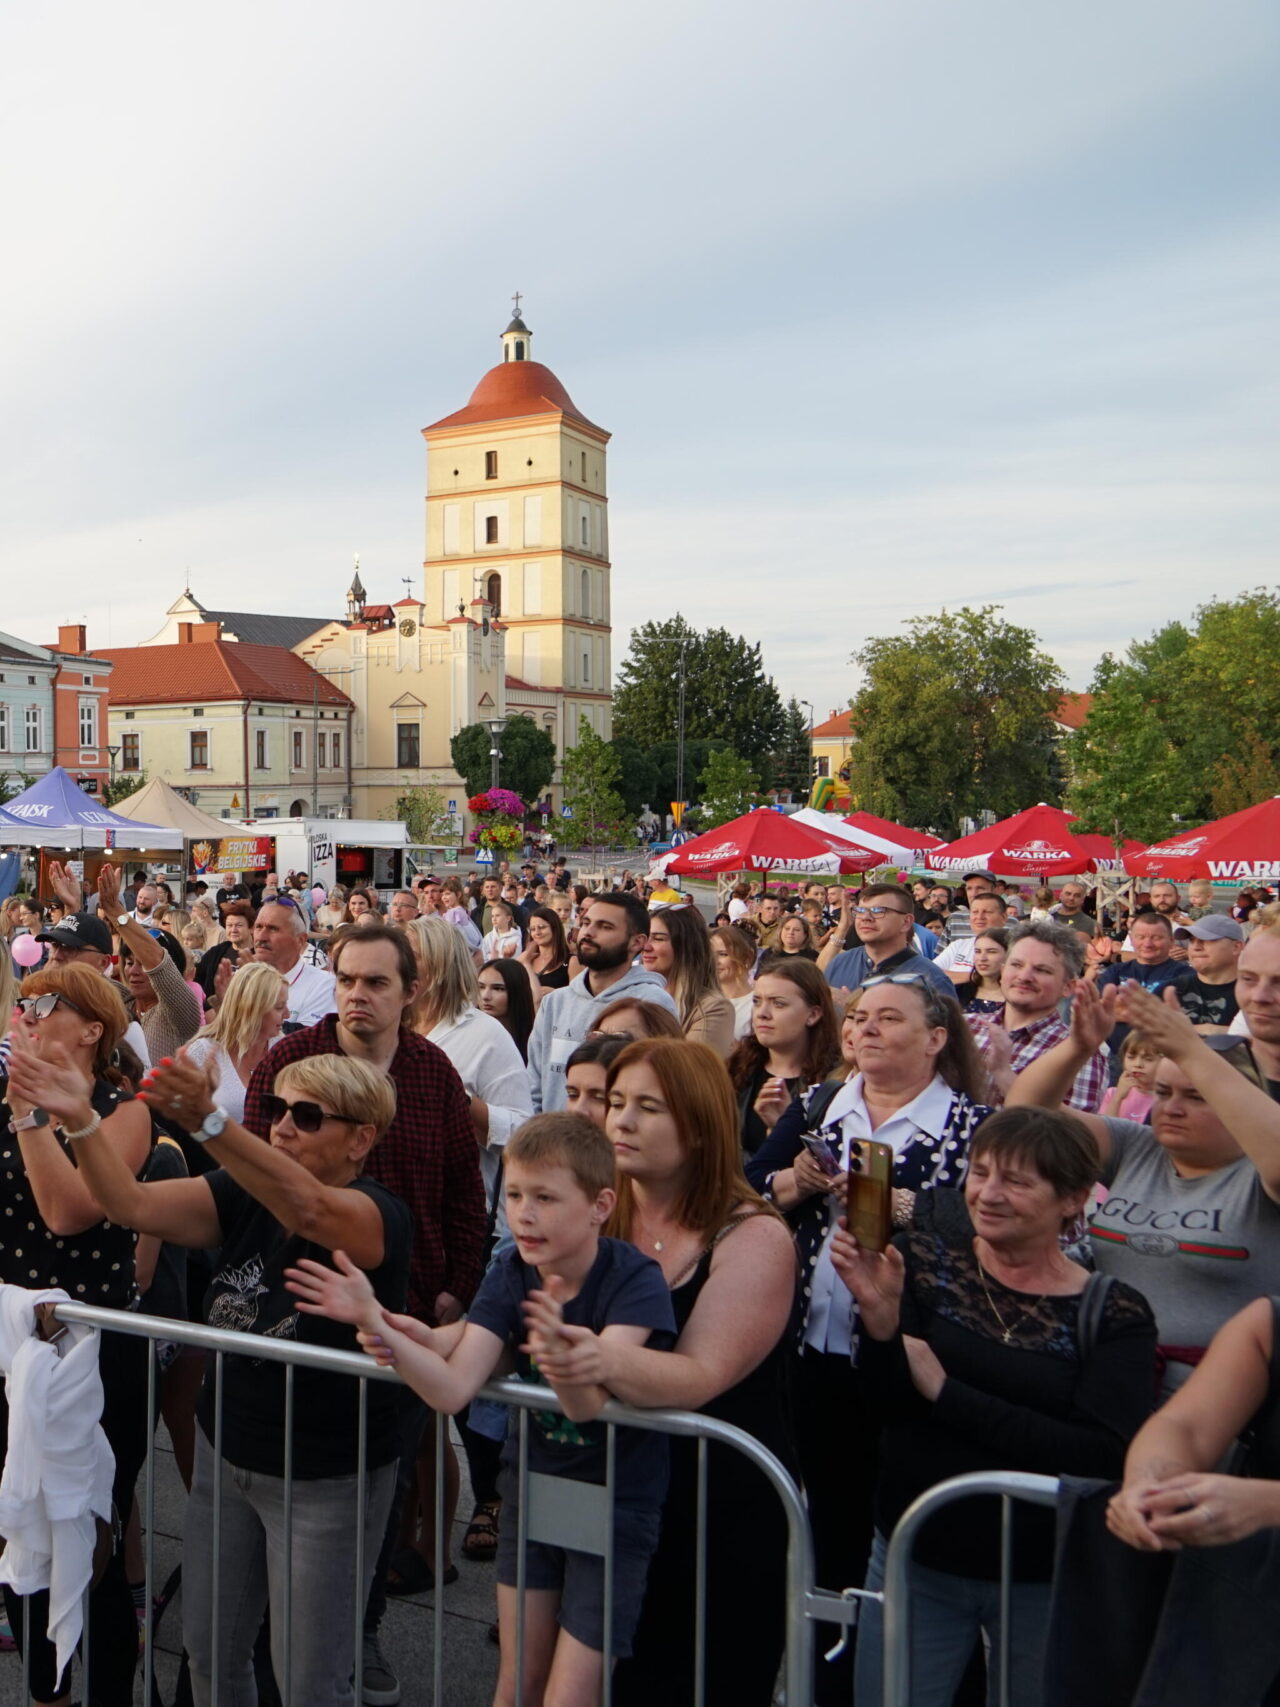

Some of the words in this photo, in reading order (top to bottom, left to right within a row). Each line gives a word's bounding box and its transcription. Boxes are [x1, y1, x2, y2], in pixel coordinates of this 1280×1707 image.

[228, 841, 257, 853] FRYTKI
[1002, 848, 1072, 860] WARKA
[218, 854, 266, 869] BELGIJSKIE
[751, 854, 832, 873] WARKA
[928, 854, 979, 872] WARKA
[1102, 1197, 1223, 1232] GUCCI
